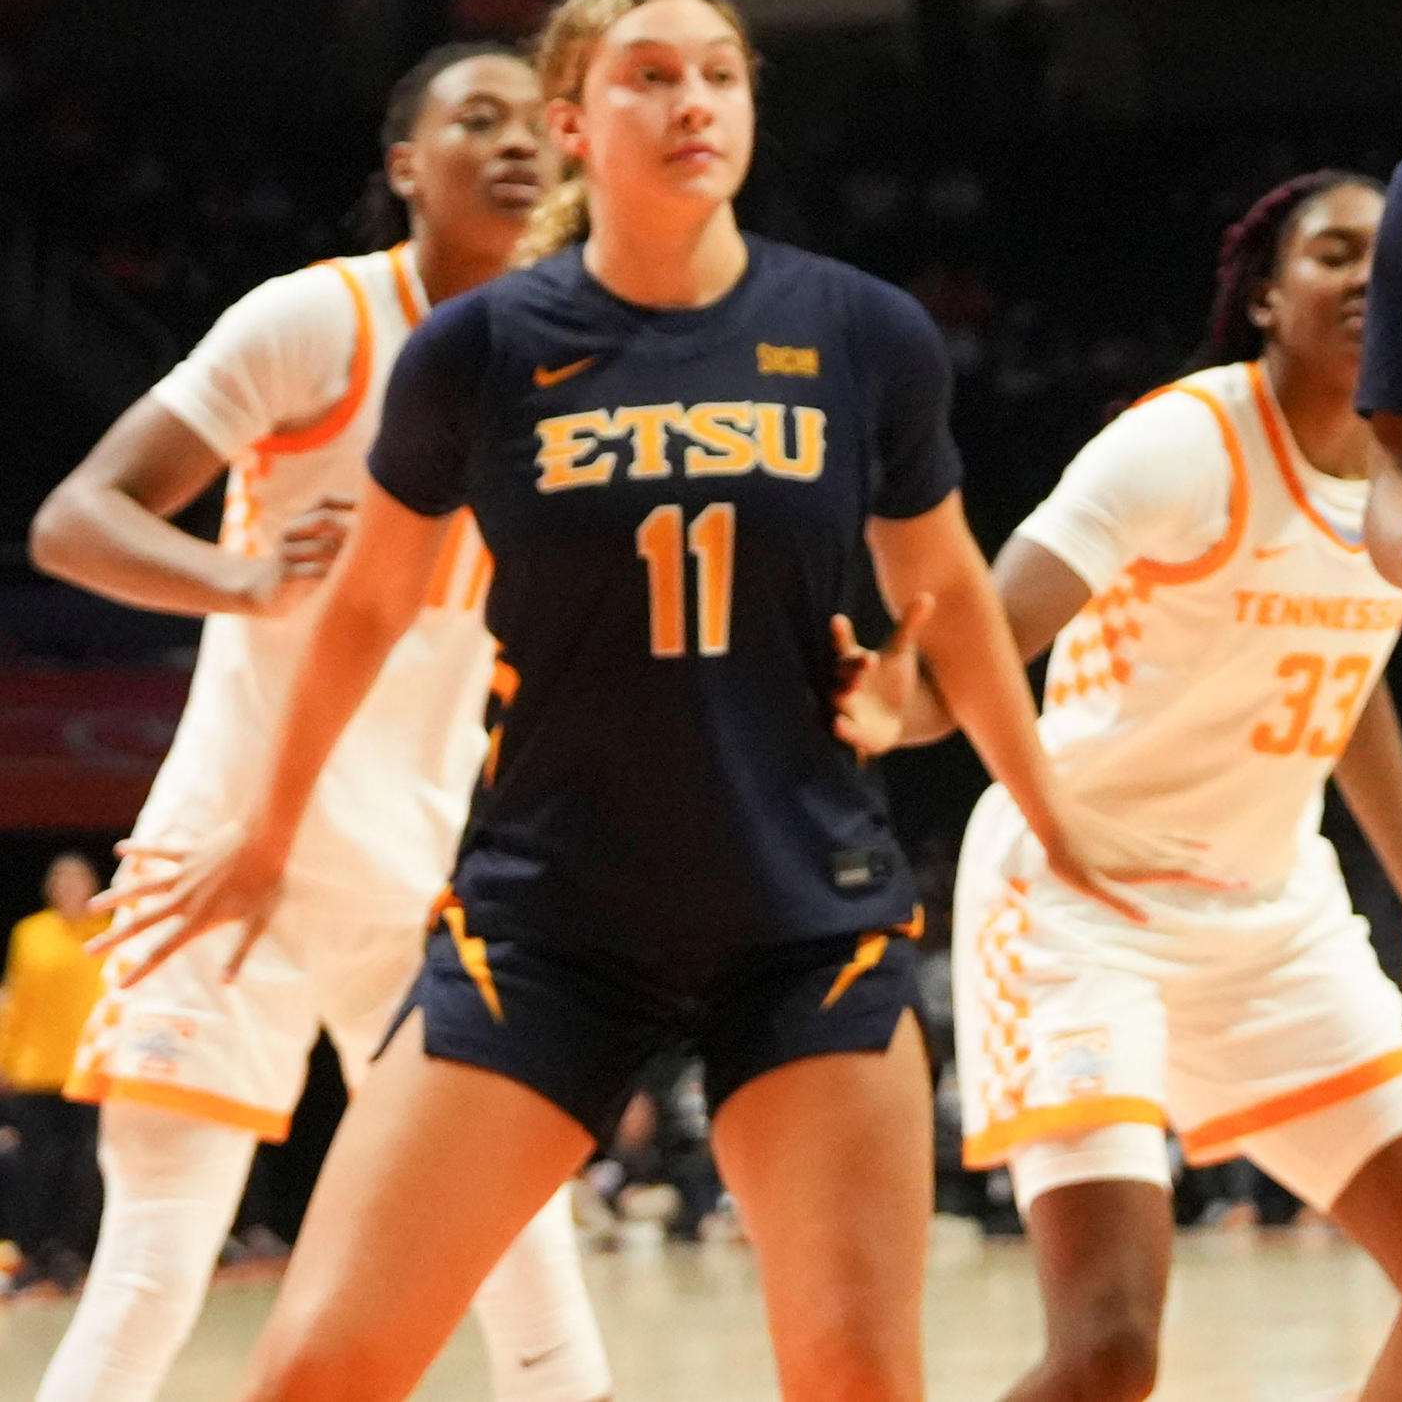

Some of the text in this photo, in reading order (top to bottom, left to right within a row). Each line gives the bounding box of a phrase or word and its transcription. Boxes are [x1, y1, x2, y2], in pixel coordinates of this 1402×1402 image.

[534, 400, 827, 495] ETSU
[634, 502, 737, 659] 11
[1251, 653, 1373, 758] 33
